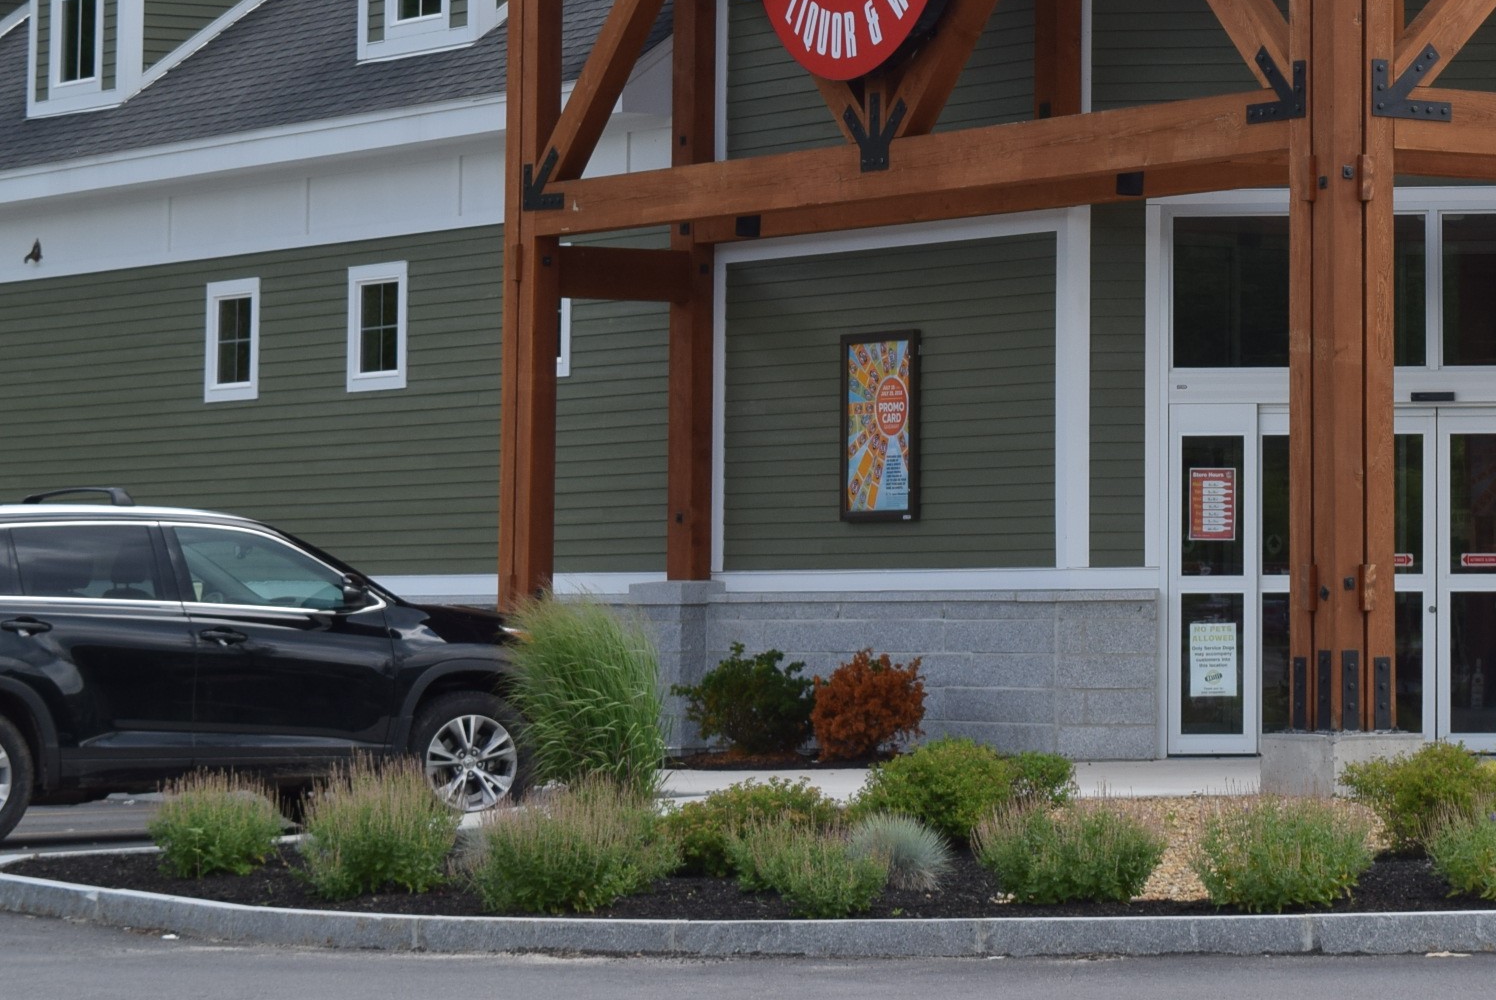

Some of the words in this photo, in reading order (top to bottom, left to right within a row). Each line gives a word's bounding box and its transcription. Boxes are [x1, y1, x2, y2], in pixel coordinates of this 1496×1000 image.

[863, 0, 883, 46] &
[878, 401, 905, 413] PROMO
[882, 412, 902, 424] CARD
[1194, 625, 1207, 633] NO
[1210, 625, 1232, 633] PETS
[1192, 634, 1234, 643] ALLOWED
